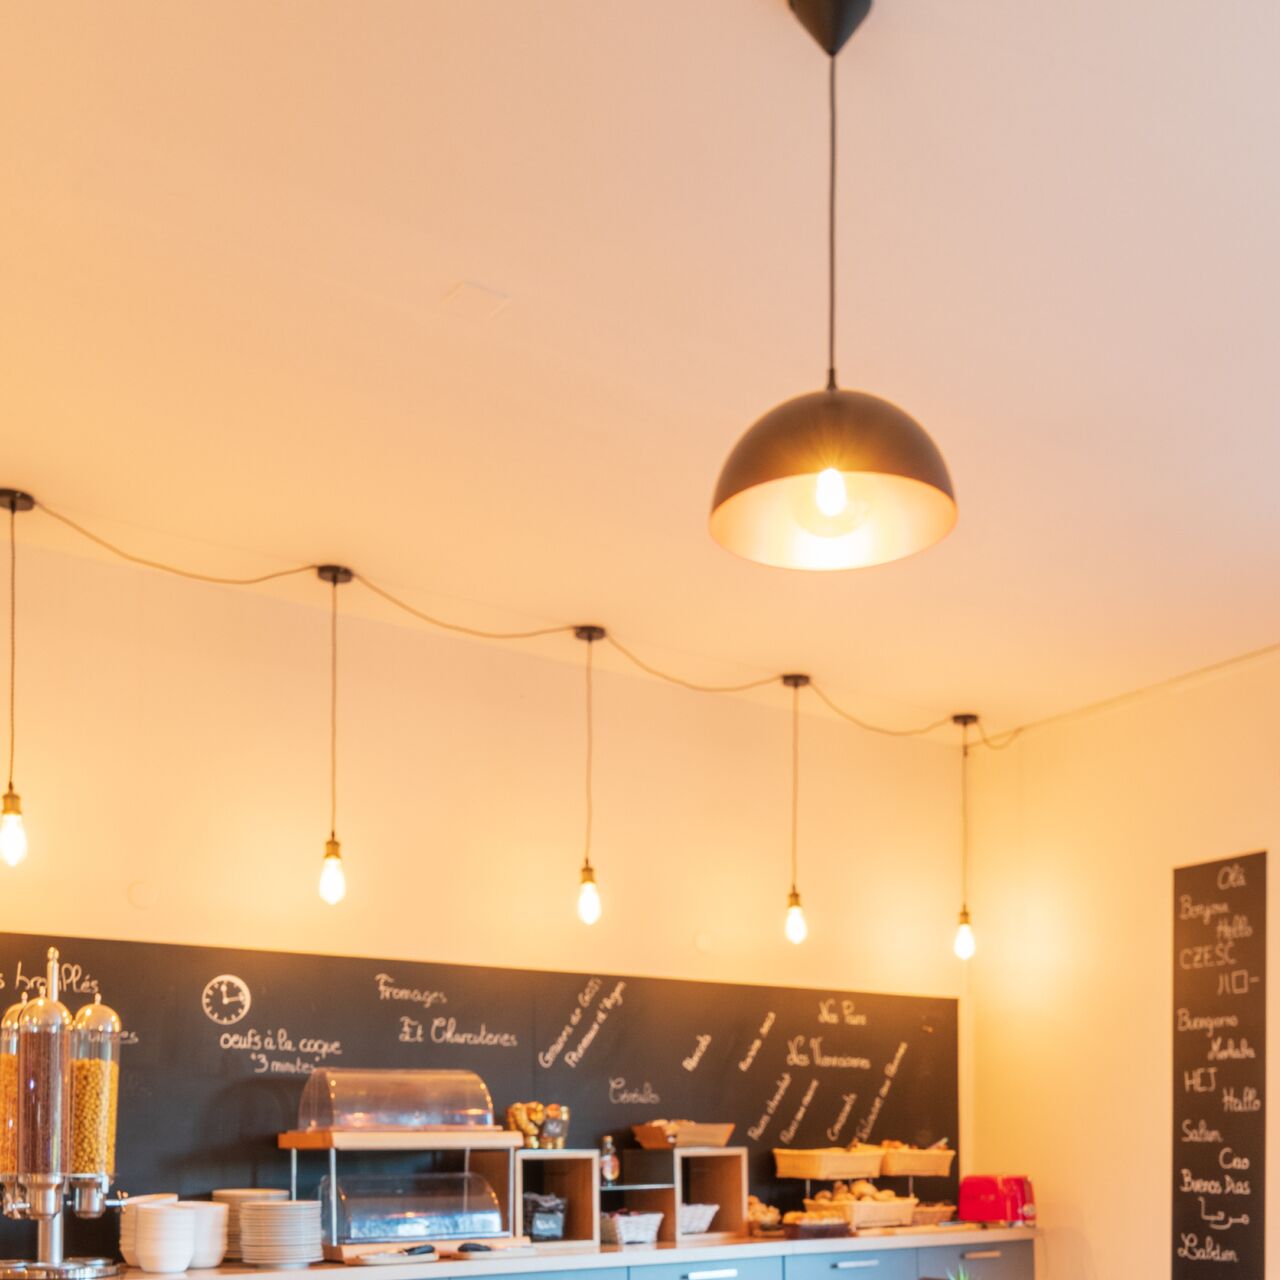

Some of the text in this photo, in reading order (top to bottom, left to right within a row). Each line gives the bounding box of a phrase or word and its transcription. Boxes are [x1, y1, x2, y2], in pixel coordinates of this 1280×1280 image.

[1217, 915, 1253, 940] Hello
[15, 961, 99, 993] broillés
[375, 973, 448, 1008] Fromages
[399, 1016, 424, 1042] Et
[277, 1028, 296, 1051] la
[299, 1038, 342, 1059] coque
[1222, 1086, 1261, 1112] Hallo
